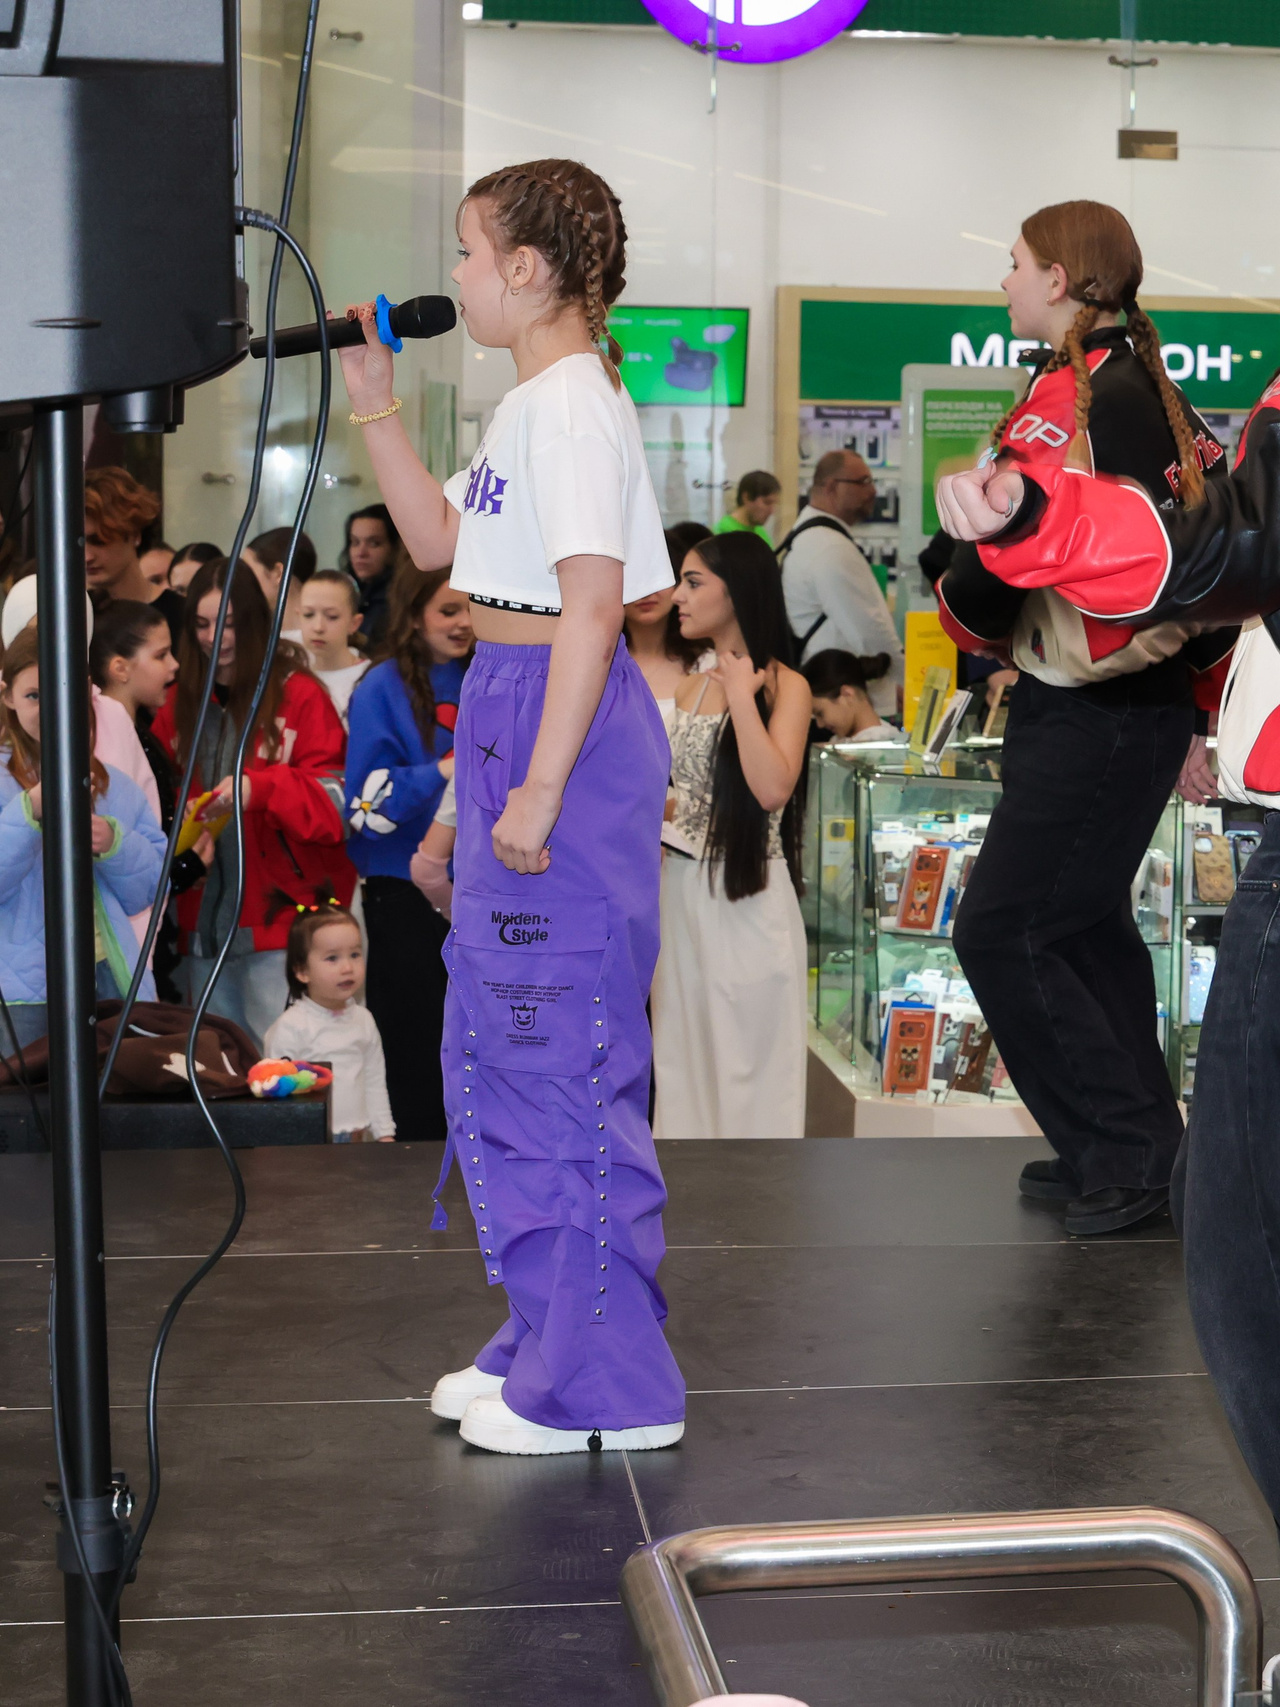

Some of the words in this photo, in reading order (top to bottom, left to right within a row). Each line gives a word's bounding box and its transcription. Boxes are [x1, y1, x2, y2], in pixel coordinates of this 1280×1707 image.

[951, 332, 1232, 381] МЕОН
[1009, 413, 1070, 448] OP
[491, 910, 541, 926] Maiden
[511, 928, 549, 945] Style
